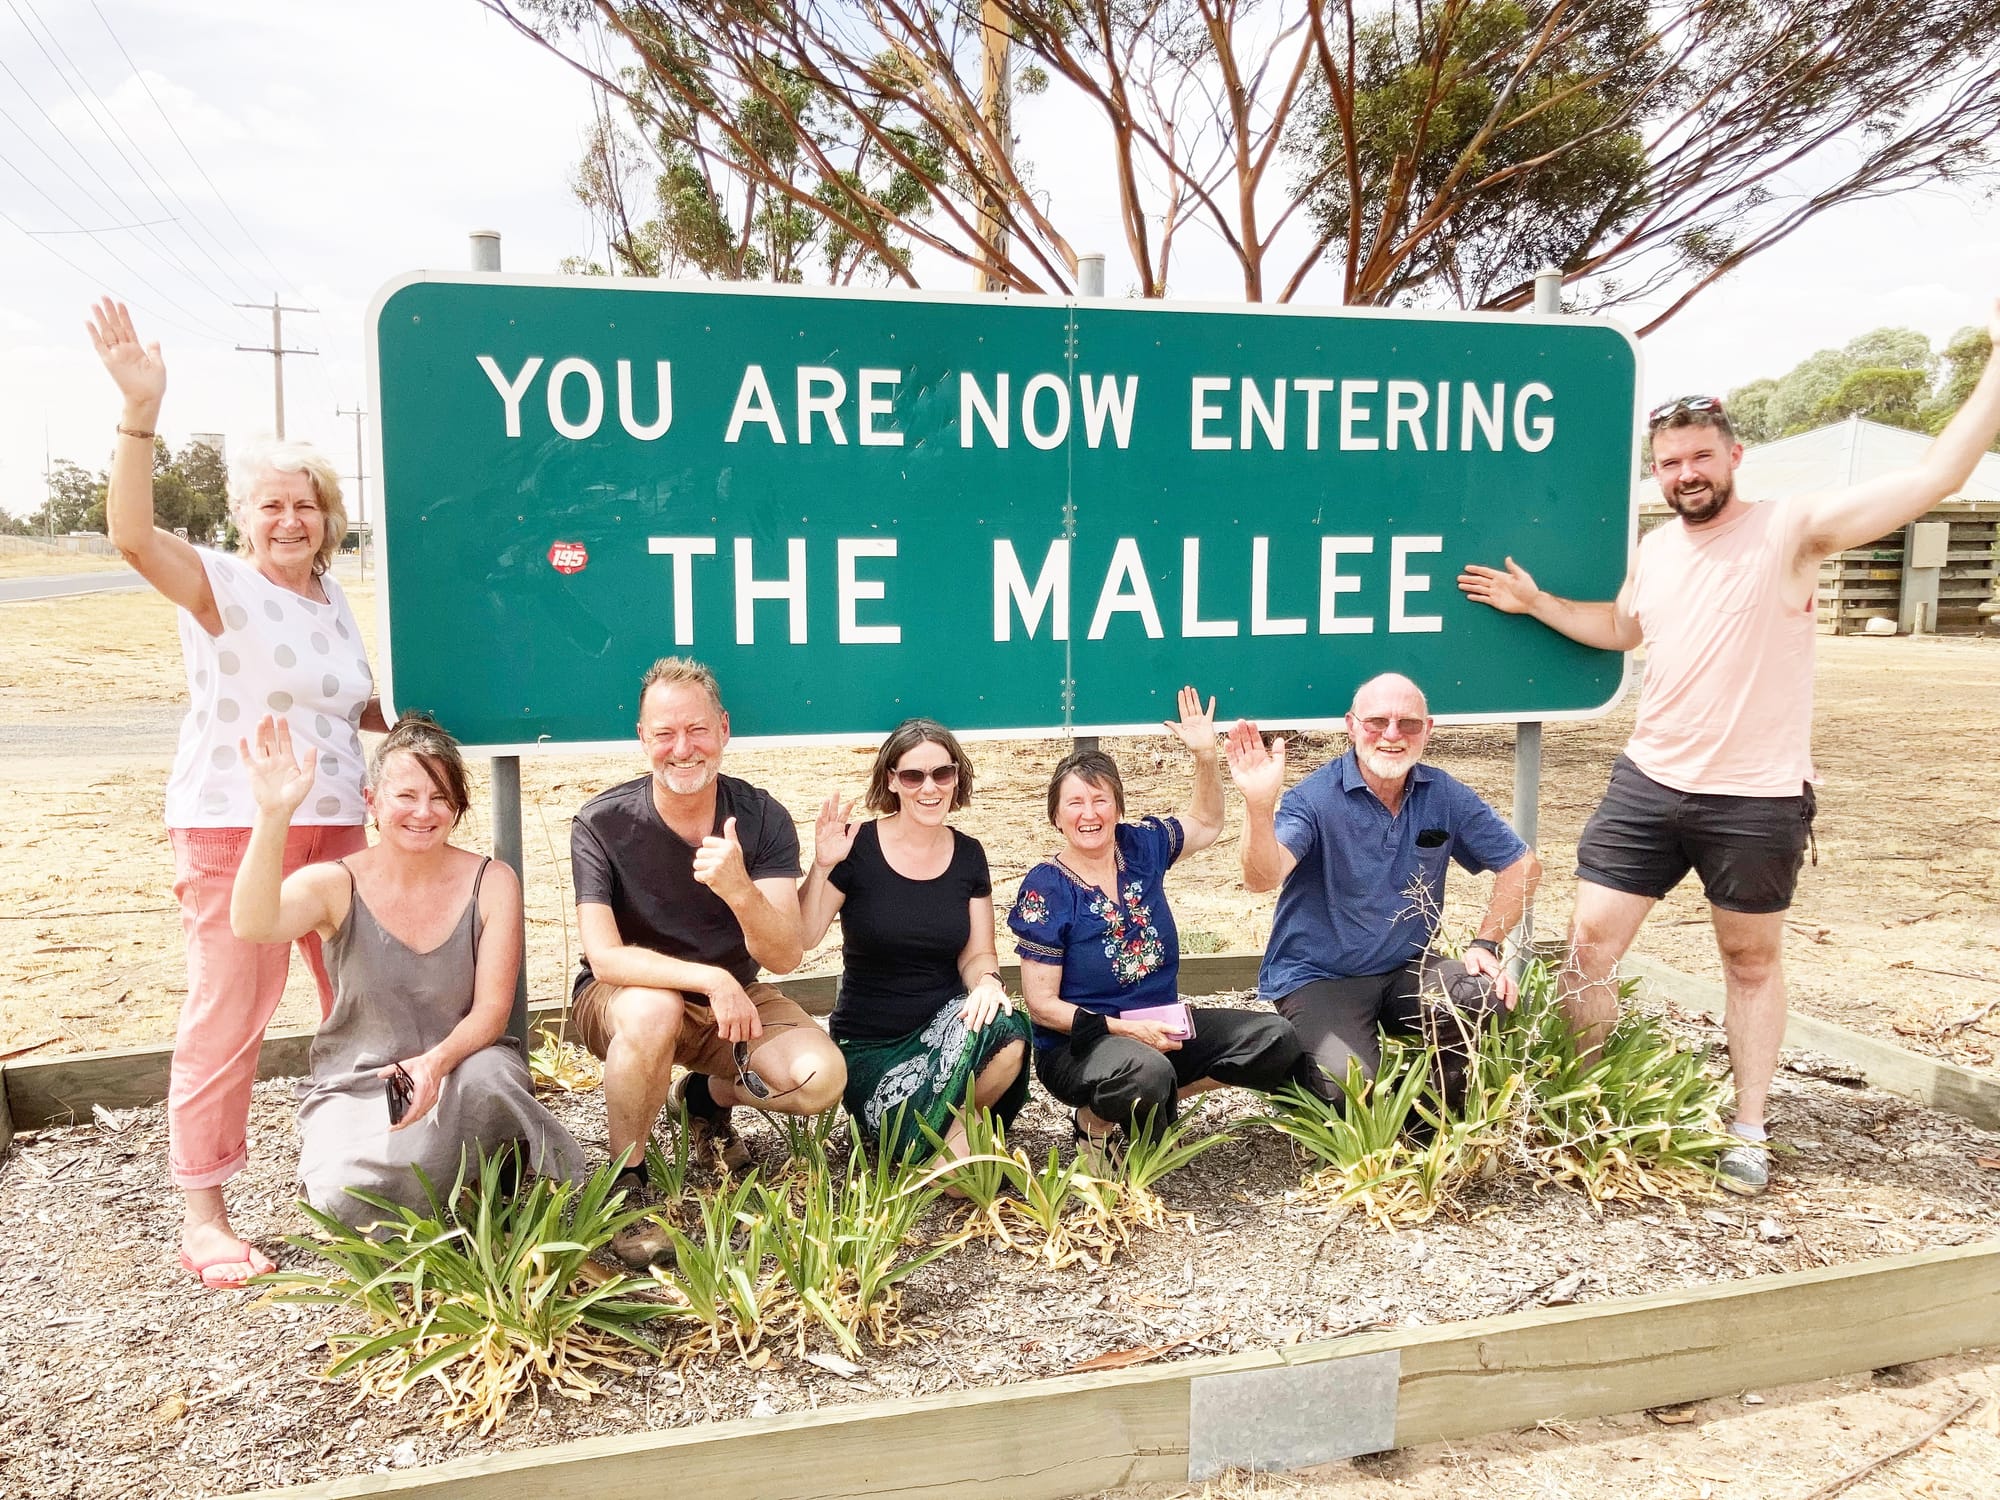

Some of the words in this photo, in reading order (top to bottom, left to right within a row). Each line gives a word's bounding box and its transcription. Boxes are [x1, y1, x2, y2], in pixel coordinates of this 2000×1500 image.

[477, 356, 673, 441] YOU
[725, 365, 904, 446] ARE
[960, 373, 1139, 450] NOW
[1191, 377, 1555, 453] ENTERING
[552, 549, 586, 567] 195
[648, 537, 902, 646] THE
[993, 536, 1443, 642] MALLEE
